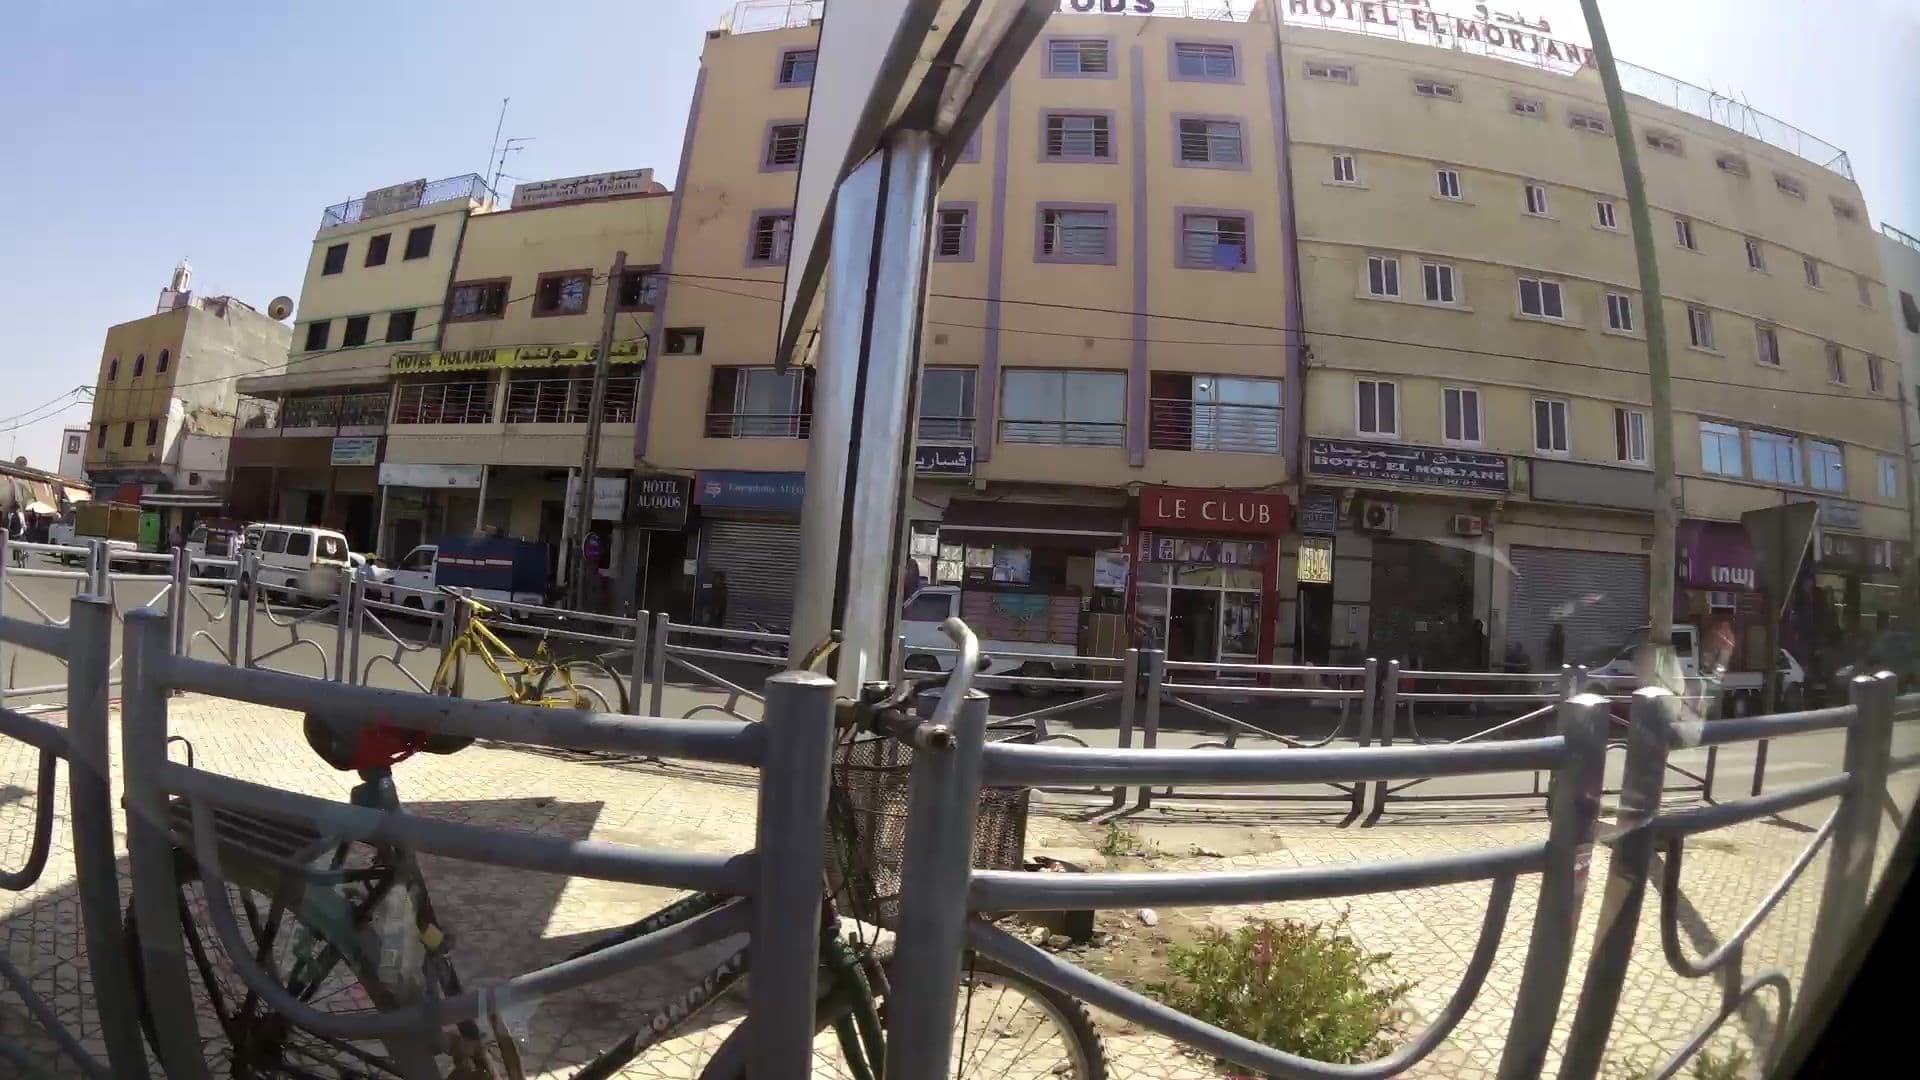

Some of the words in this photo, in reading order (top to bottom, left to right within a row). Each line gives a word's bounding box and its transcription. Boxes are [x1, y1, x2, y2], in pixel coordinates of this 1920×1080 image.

[1290, 0, 1398, 26] HOTEL
[1412, 12, 1447, 34] EL
[1457, 18, 1599, 69] MORJANE
[396, 351, 433, 368] HOTEL
[439, 348, 496, 366] HOLANDA
[1314, 455, 1381, 471] HOTEL
[1386, 462, 1410, 473] EL
[1415, 464, 1505, 482] MORJANE
[642, 480, 679, 494] HOTEL
[1158, 497, 1187, 519] LE
[1202, 500, 1271, 525] CLUB
